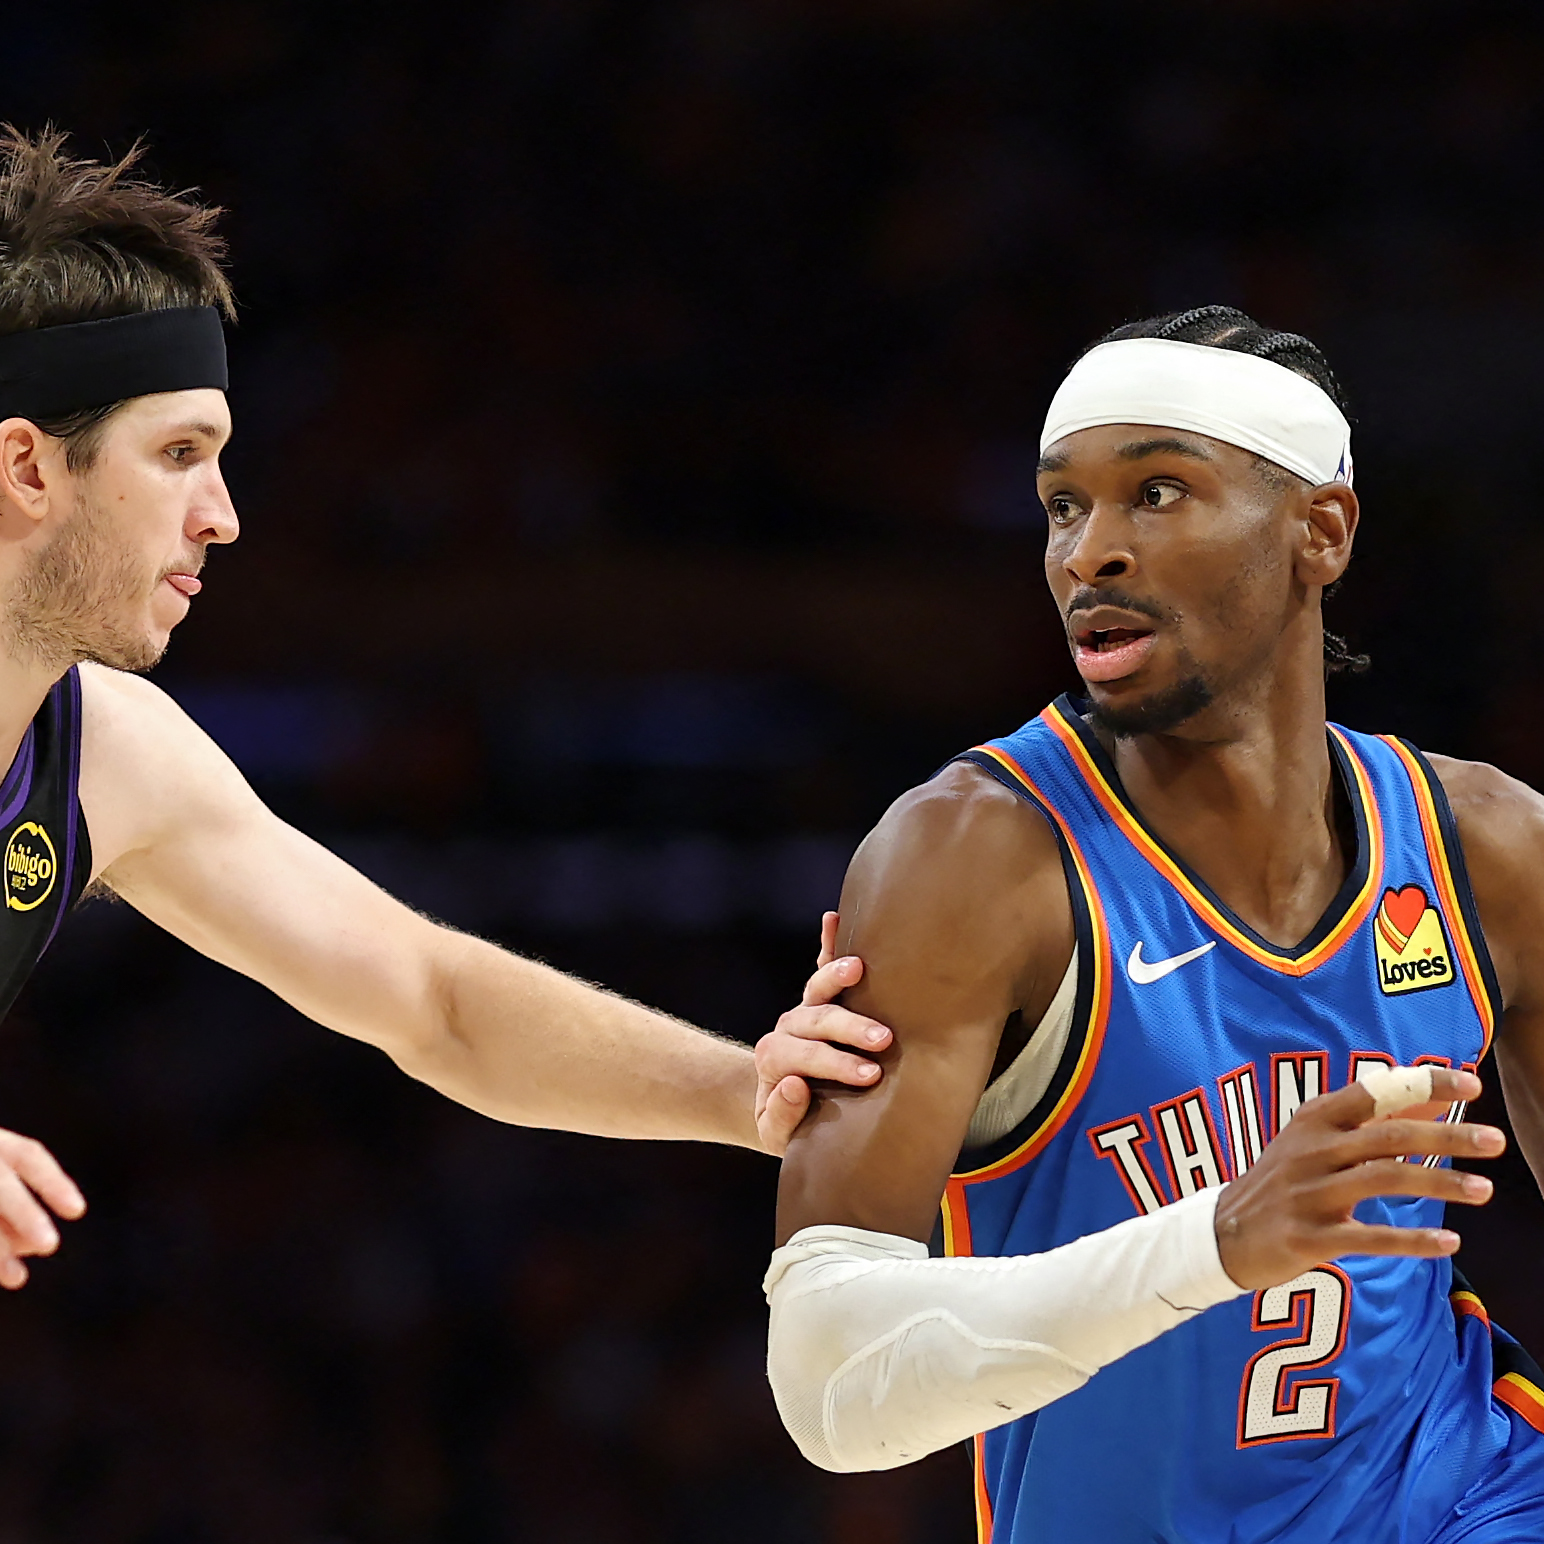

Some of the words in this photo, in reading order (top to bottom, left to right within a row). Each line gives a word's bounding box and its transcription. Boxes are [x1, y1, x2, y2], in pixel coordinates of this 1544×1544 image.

[8, 843, 52, 887] bibigo
[1087, 1051, 1478, 1216] THUN
[1236, 1263, 1353, 1450] 2
